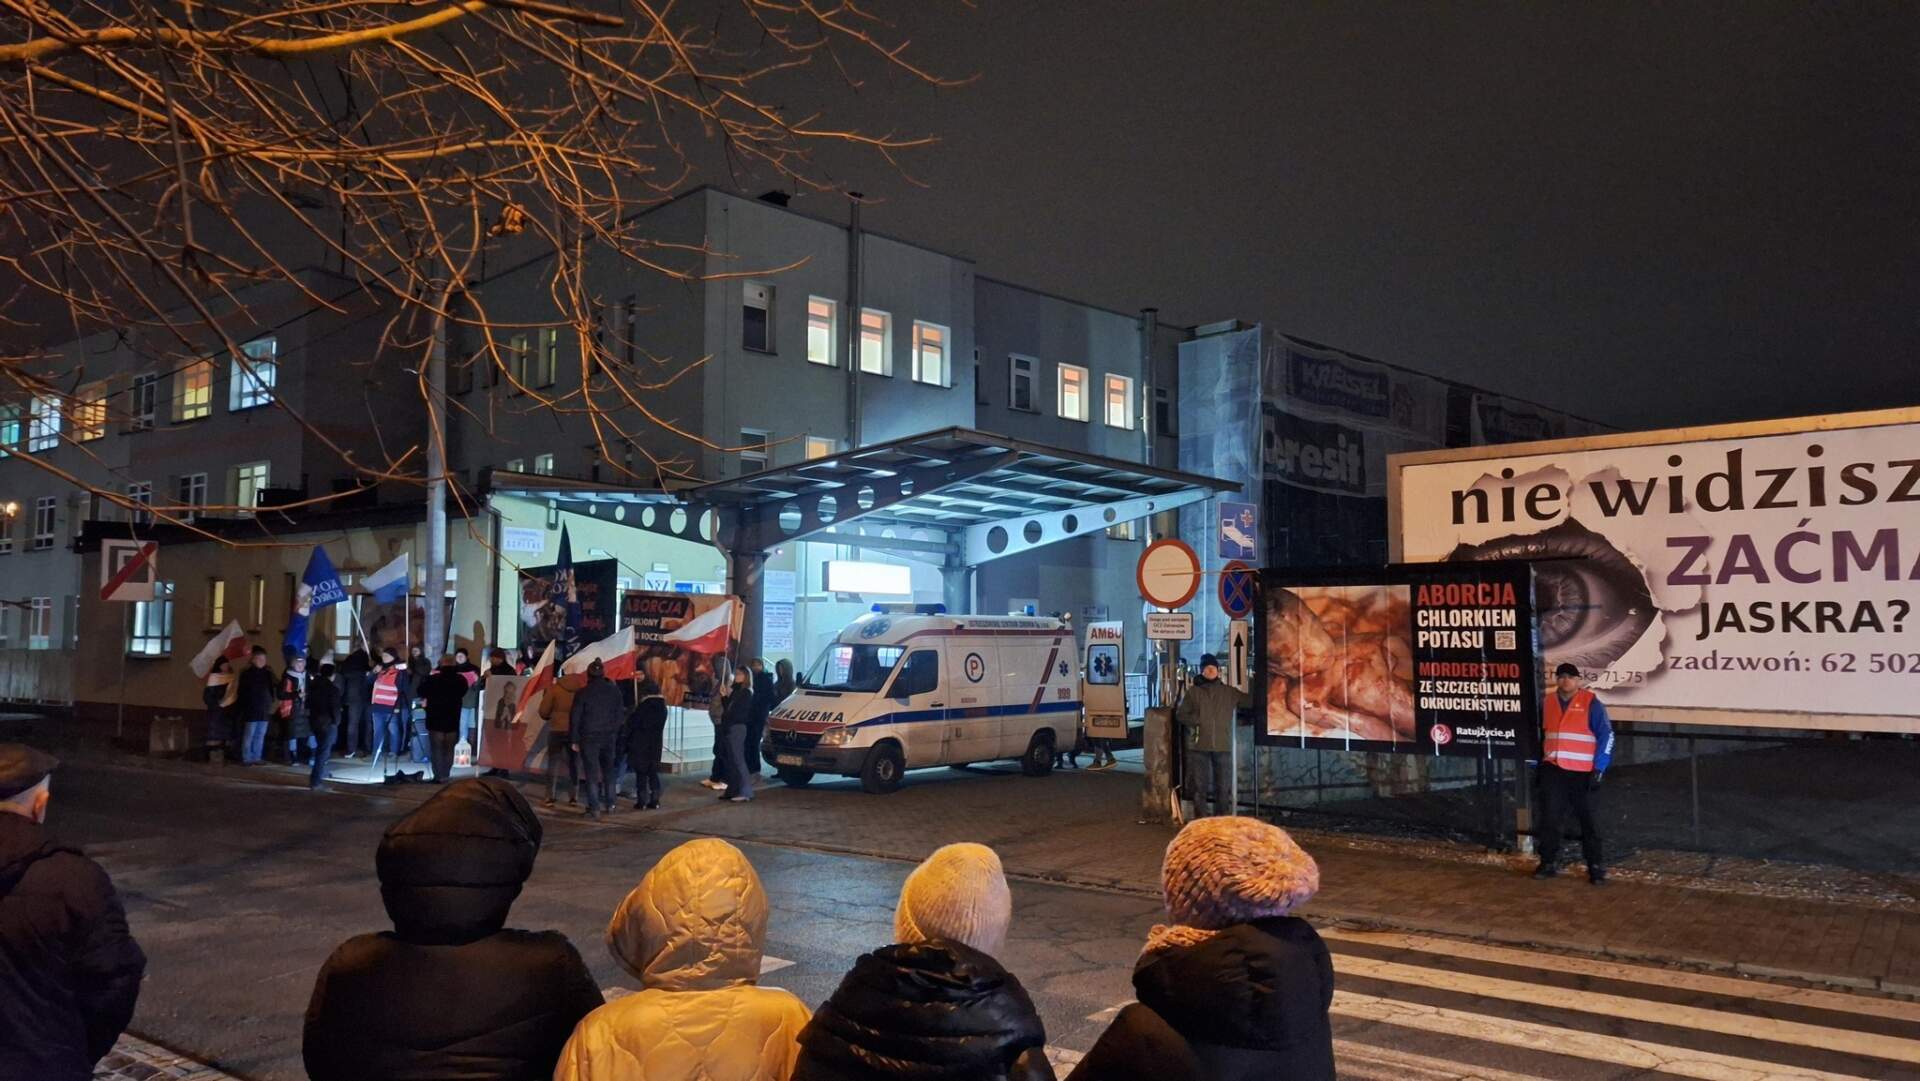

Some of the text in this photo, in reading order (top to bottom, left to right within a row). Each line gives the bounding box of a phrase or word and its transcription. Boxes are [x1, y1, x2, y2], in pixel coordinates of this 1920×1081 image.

[1451, 444, 1920, 525] nie widzisz
[1417, 582, 1516, 606] ABORCJA
[624, 597, 682, 616] ABORCJA
[1417, 609, 1516, 627] CHLORKIEM
[1696, 599, 1911, 641] JASKRA?
[1090, 628, 1122, 640] AMBU
[1418, 630, 1484, 648] POTASU
[969, 660, 979, 675] P
[1669, 650, 1920, 673] zadzwoń: 62 502
[1419, 662, 1520, 679] MORDERSTWO
[1602, 671, 1643, 683] 71-75
[1420, 679, 1520, 695] ZE SZCZEGÓLNYM
[1420, 695, 1521, 712] OKRUCIEŃSTWEM
[1456, 726, 1515, 739] RatujŻycie.pl
